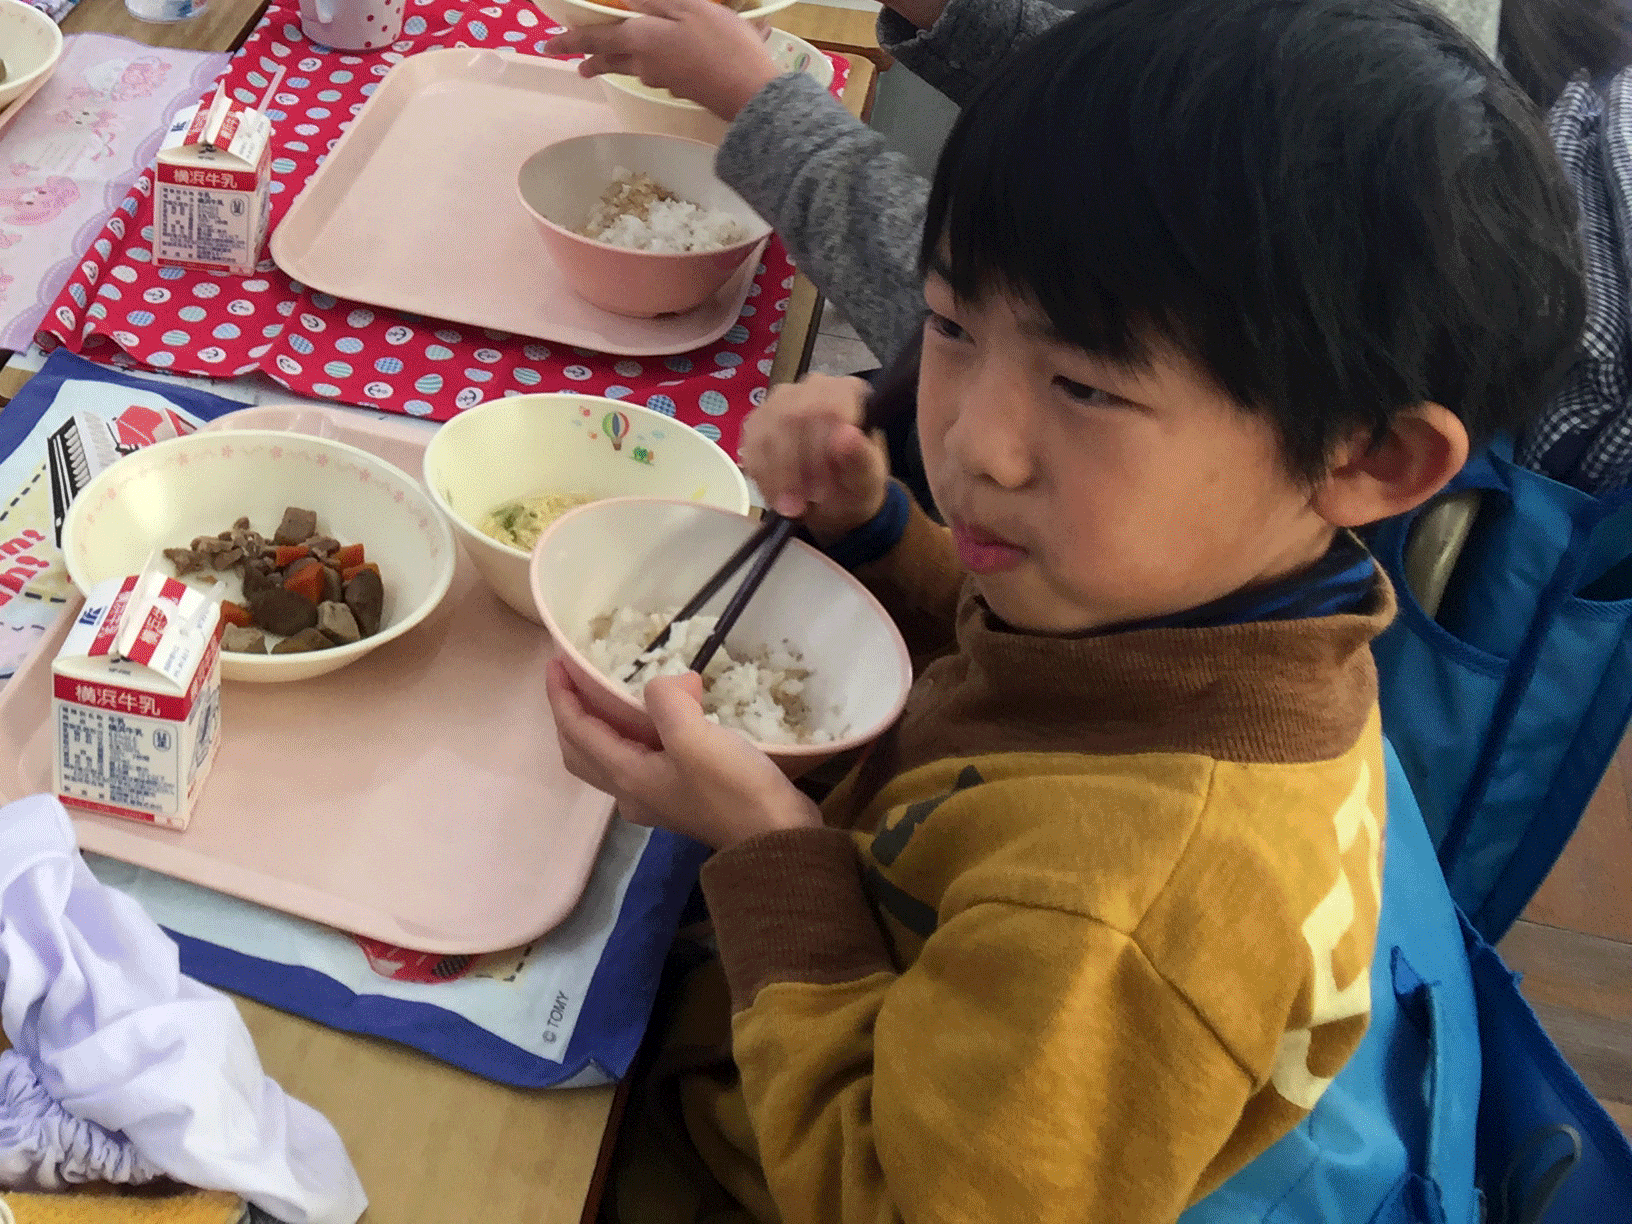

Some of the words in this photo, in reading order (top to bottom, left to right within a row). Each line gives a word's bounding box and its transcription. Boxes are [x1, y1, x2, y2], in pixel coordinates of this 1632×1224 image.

[173, 169, 238, 189] 横浜牛乳
[75, 685, 161, 716] 横浜牛乳
[547, 990, 569, 1028] TOMY
